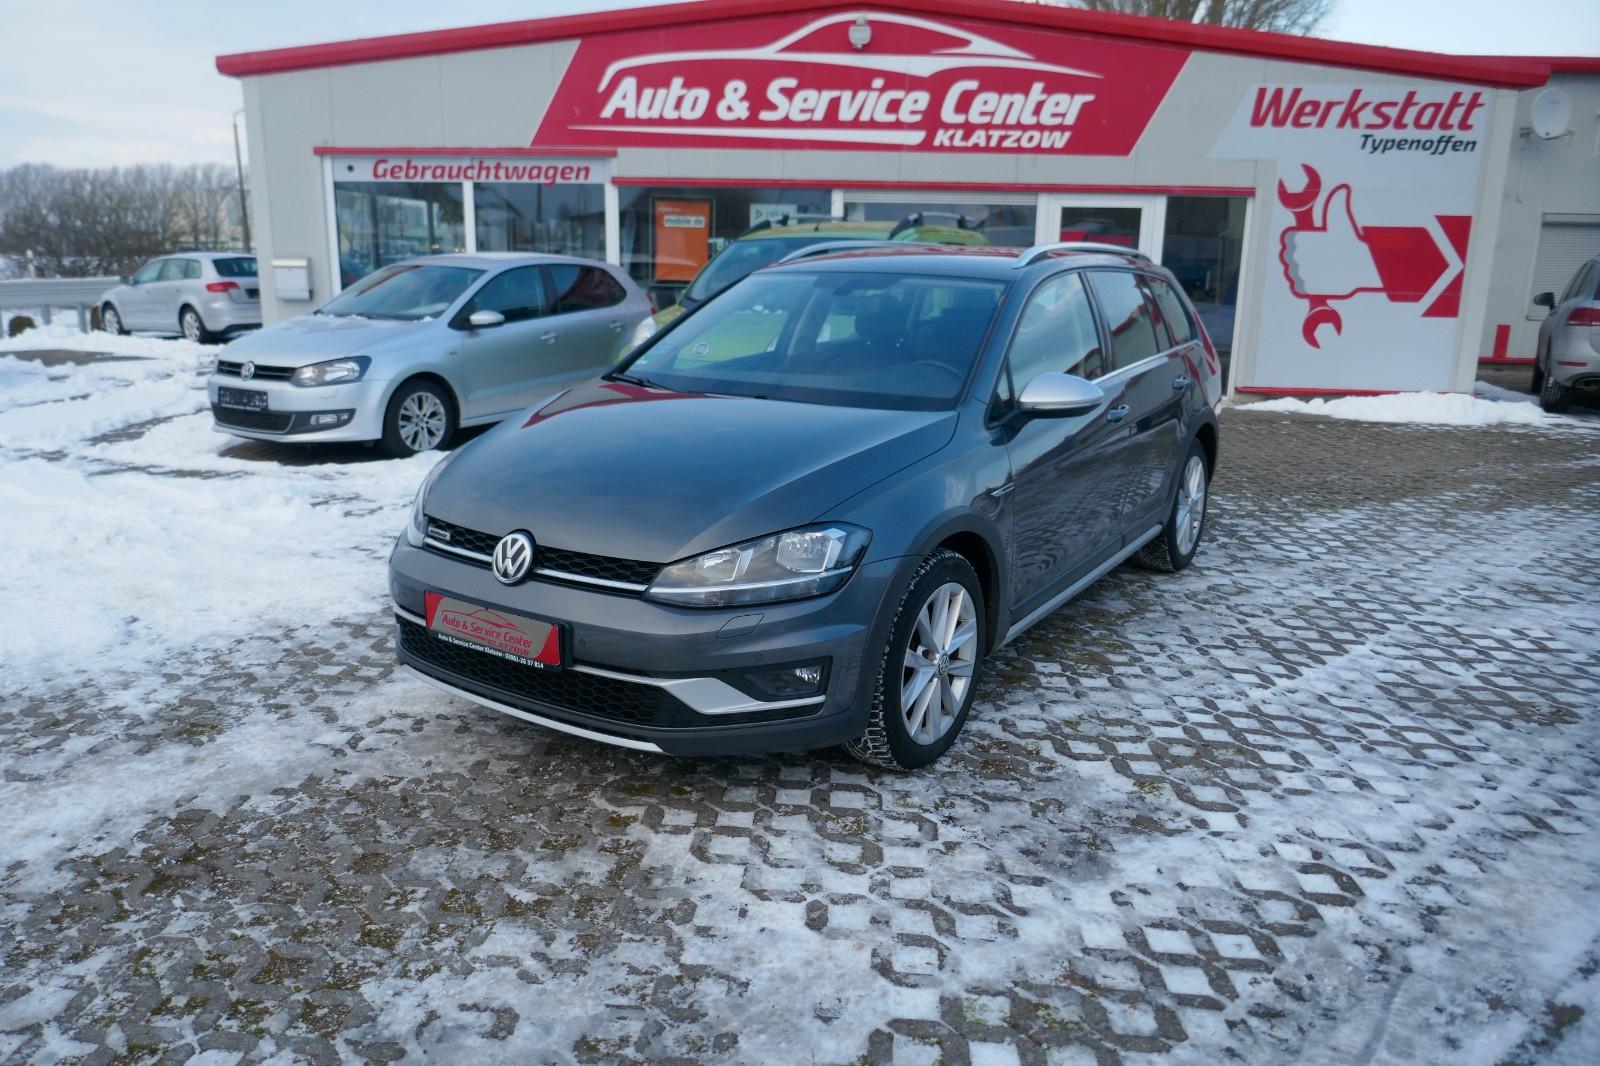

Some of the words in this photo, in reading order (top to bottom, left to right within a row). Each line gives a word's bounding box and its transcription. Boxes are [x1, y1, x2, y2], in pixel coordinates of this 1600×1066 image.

[600, 76, 711, 121] Auto
[717, 79, 750, 121] &
[758, 77, 931, 124] Service
[940, 79, 1096, 126] Center
[1250, 86, 1486, 132] Werkstatt
[932, 128, 1072, 149] KLATZOW
[1360, 134, 1479, 156] Typenoffen
[372, 158, 591, 187] Gebrauchtwagen
[441, 614, 461, 629] Auto
[462, 621, 468, 630] &
[470, 622, 502, 638] Service
[503, 630, 532, 649] Center
[453, 637, 469, 648] Service
[469, 642, 485, 652] Center
